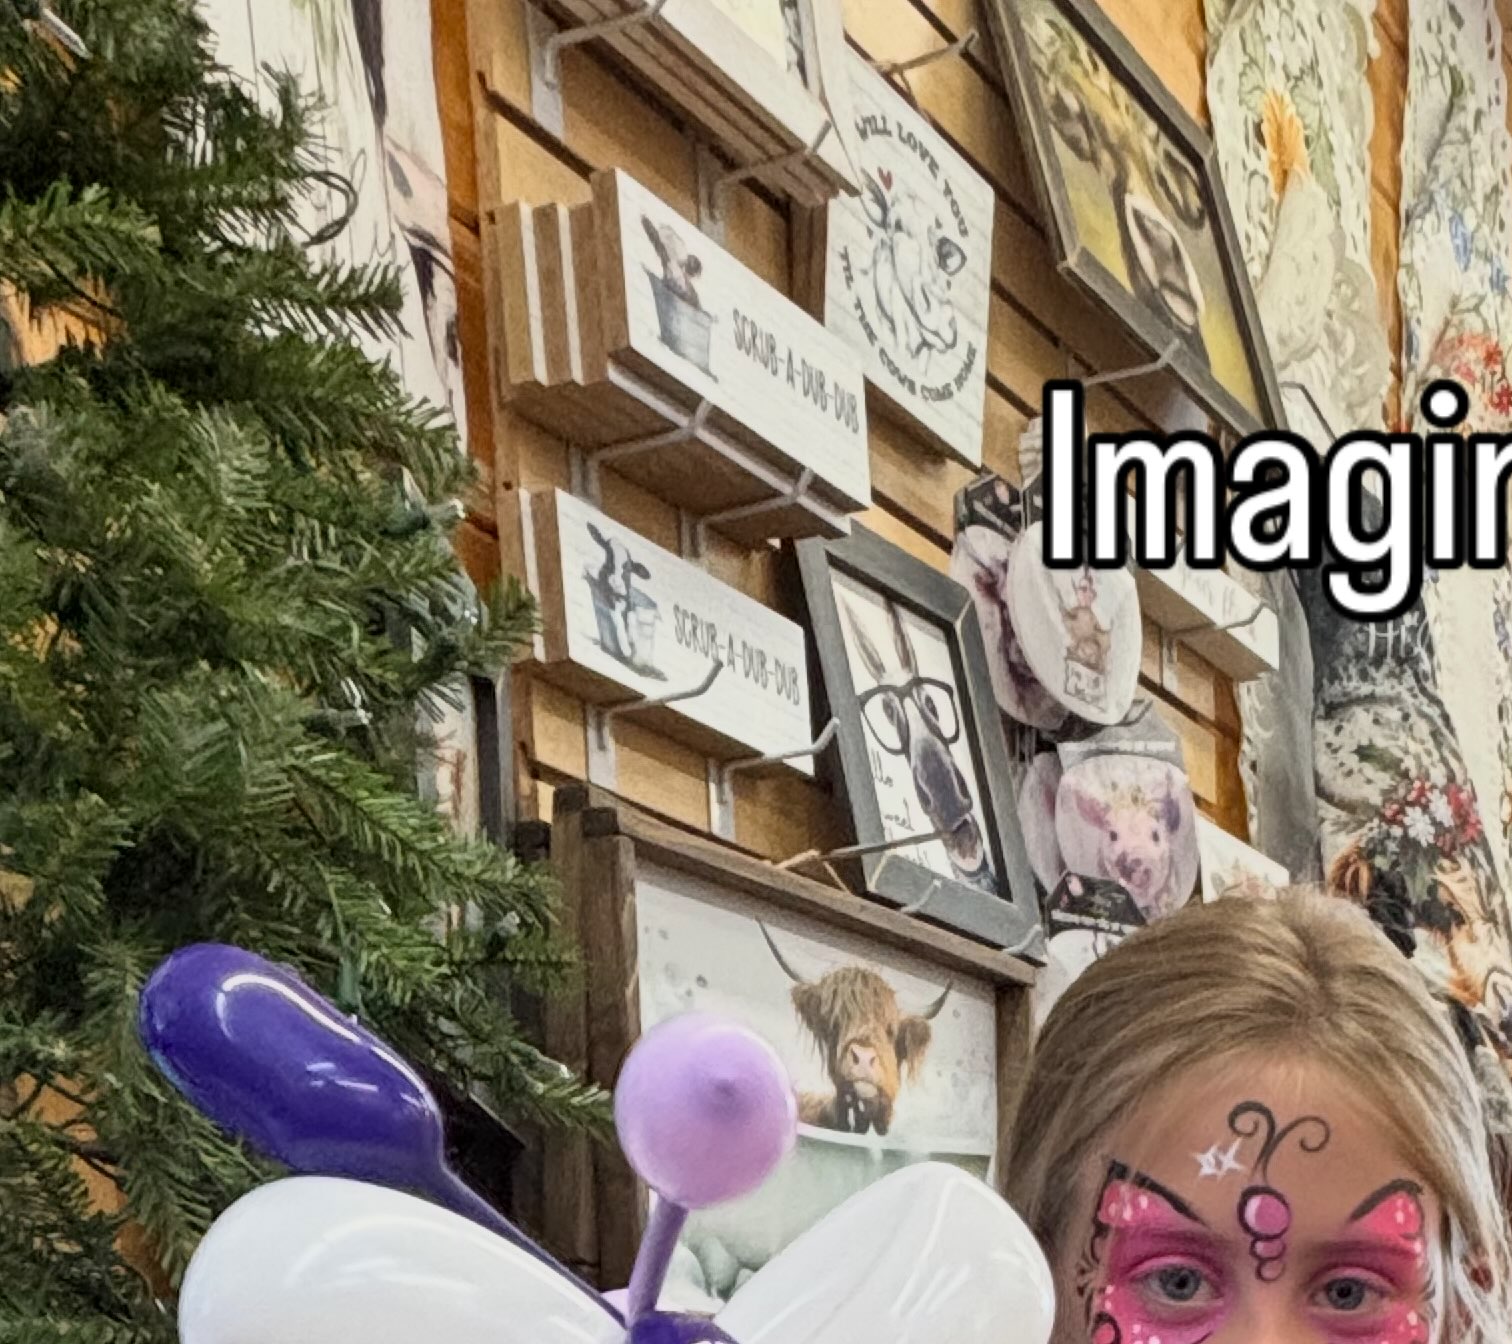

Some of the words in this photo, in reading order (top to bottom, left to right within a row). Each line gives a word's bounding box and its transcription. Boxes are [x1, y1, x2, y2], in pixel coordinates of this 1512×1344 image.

[896, 121, 939, 181] LOVE
[942, 178, 968, 237] YOU
[732, 307, 860, 434] SCRUB-A-DUB-DUB
[672, 603, 800, 706] SCRUB-A-DUB-DUB
